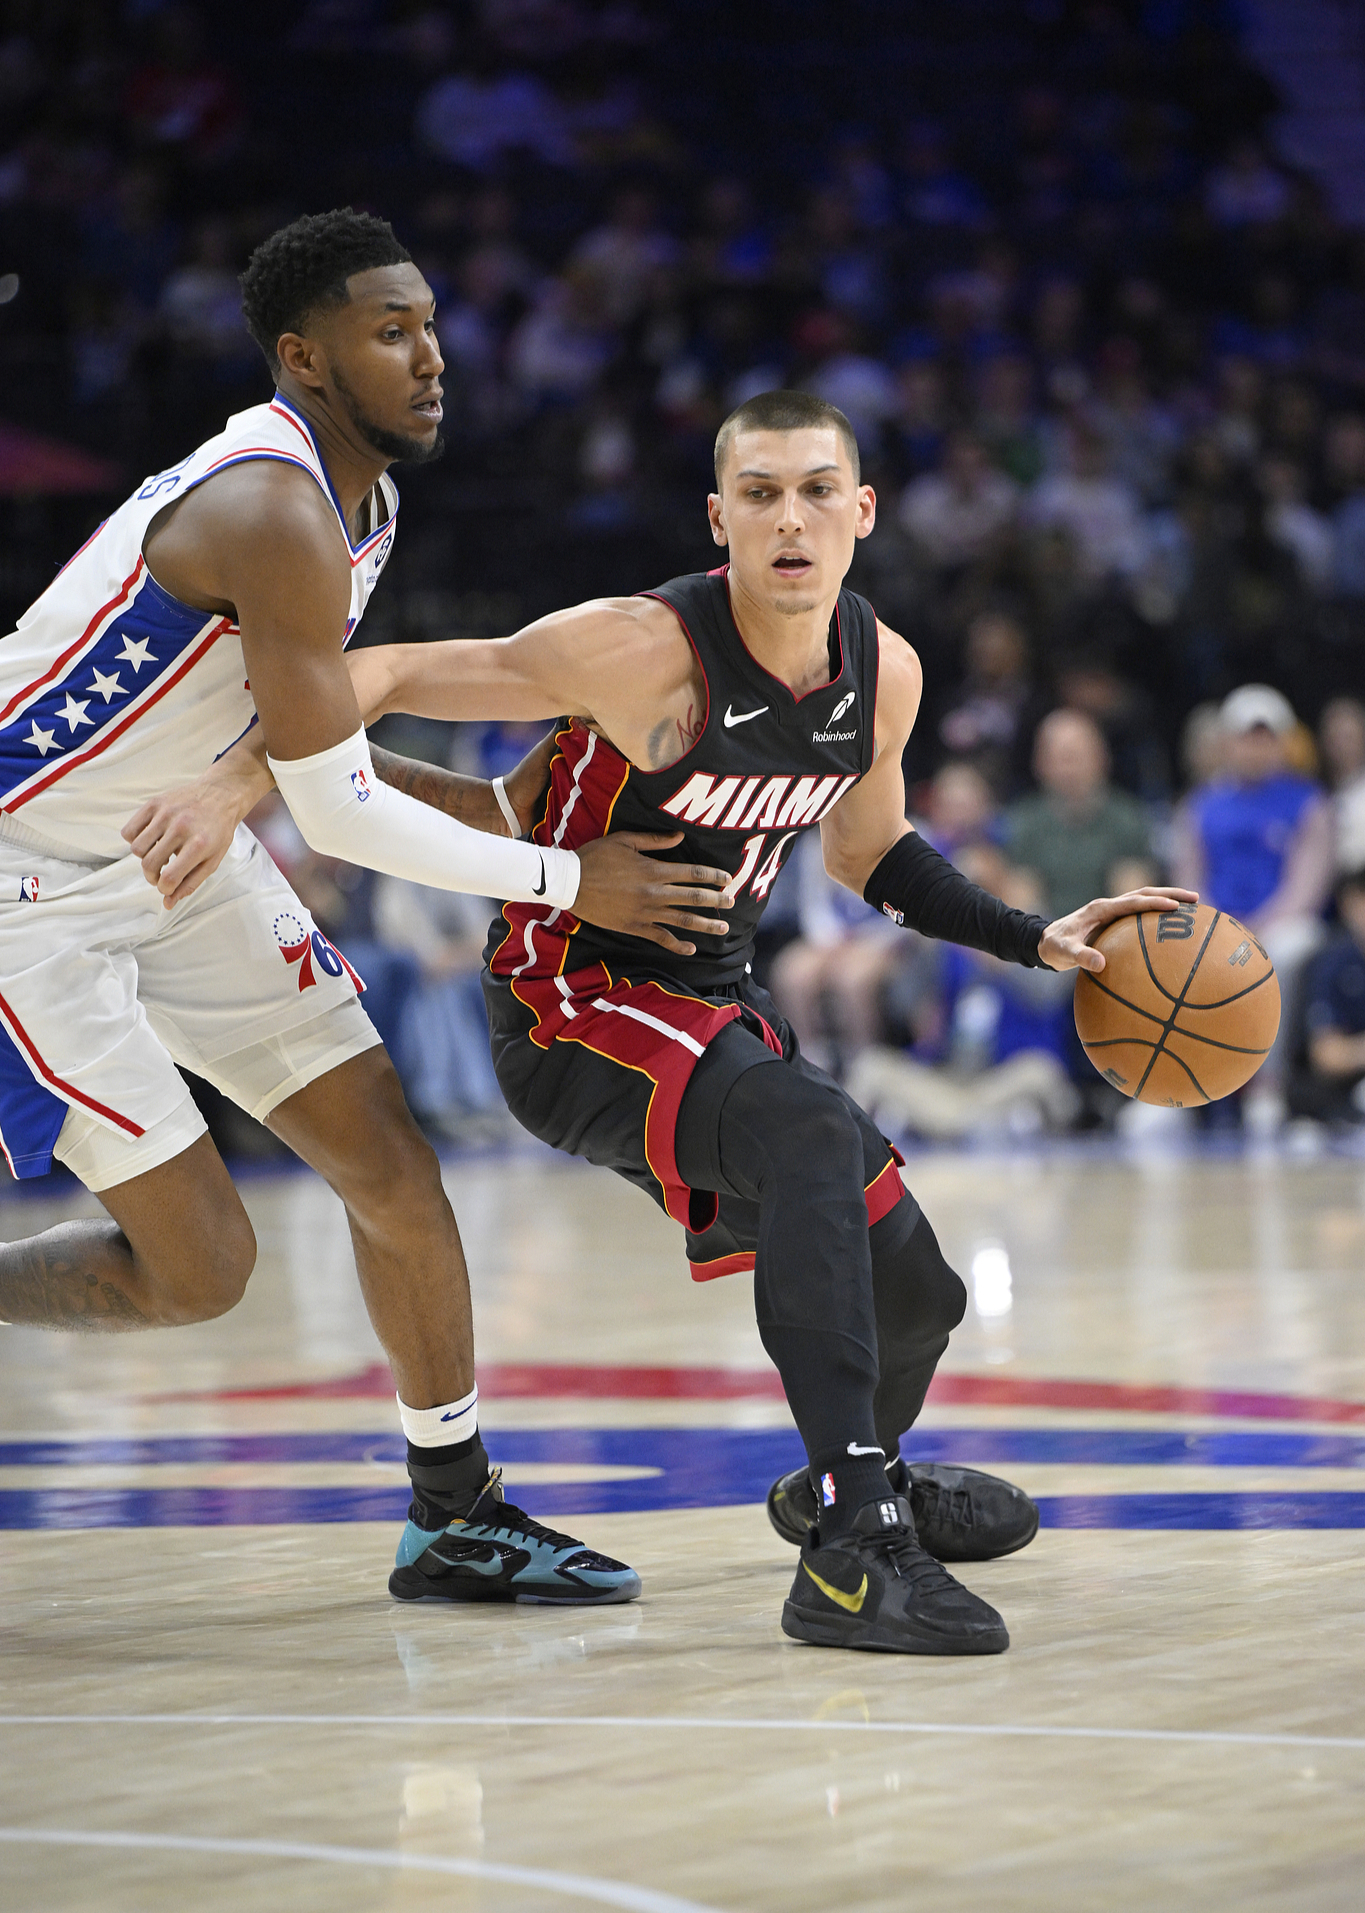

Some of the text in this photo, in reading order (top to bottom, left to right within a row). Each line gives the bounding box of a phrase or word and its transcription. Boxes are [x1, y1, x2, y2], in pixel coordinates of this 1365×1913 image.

[812, 729, 857, 743] Robinhood
[658, 770, 861, 830] MIAMI
[720, 831, 799, 903] 14
[278, 930, 344, 993] 76
